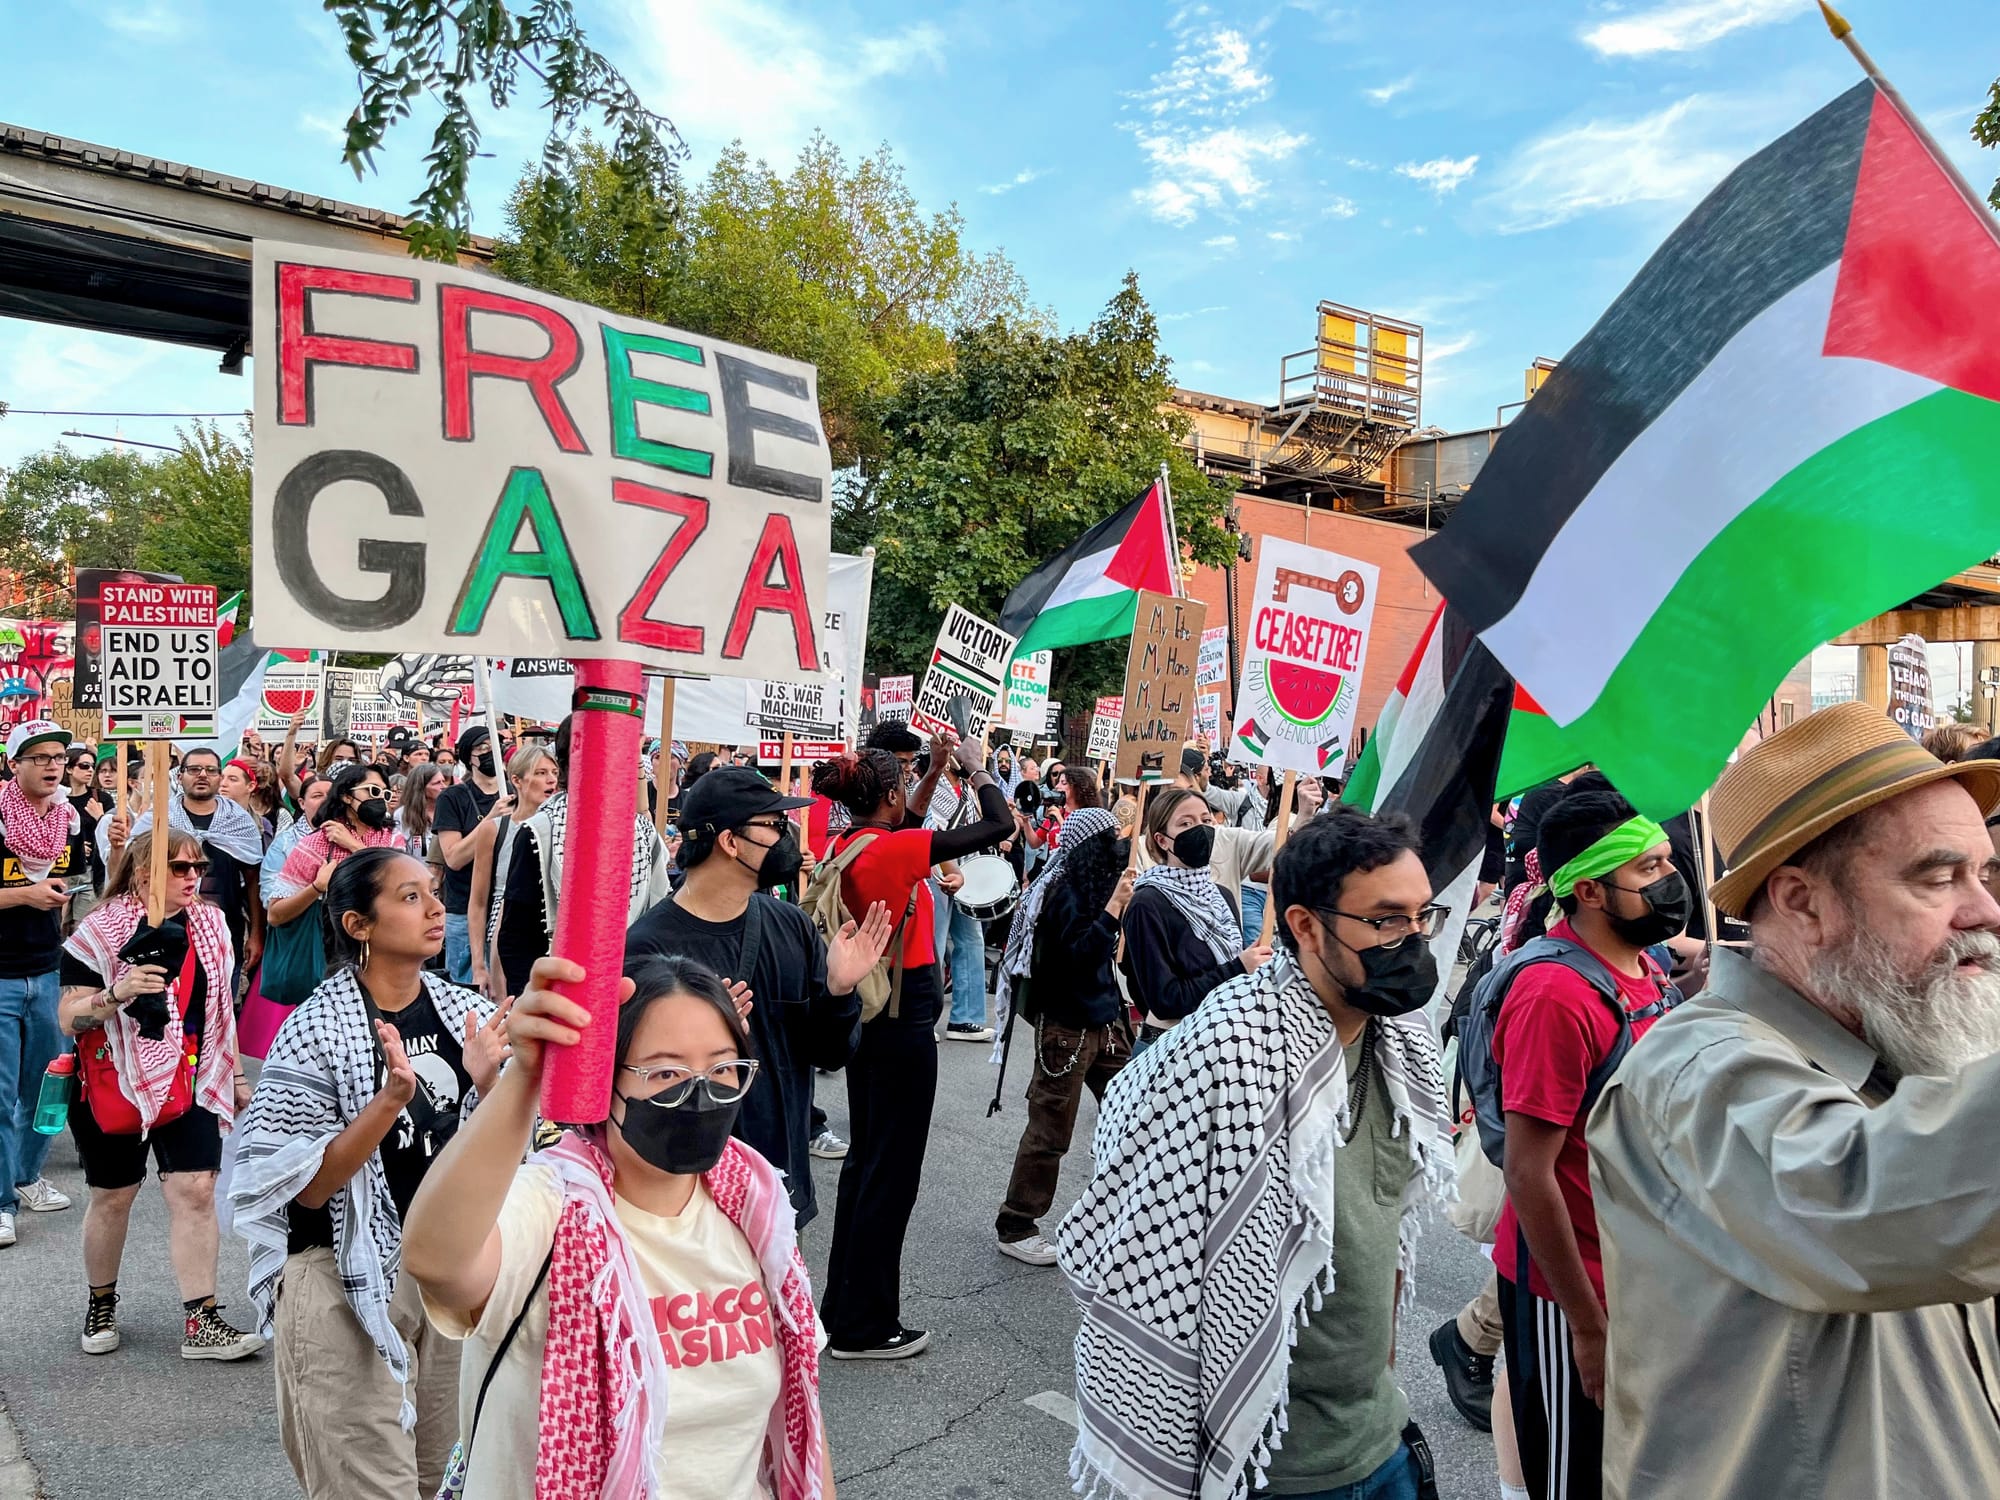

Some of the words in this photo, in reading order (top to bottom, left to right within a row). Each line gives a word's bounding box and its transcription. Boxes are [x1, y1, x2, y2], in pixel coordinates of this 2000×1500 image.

[274, 260, 822, 503] FREE
[272, 449, 821, 672] GAZA
[103, 587, 164, 603] STAND
[170, 589, 213, 604] WITH
[104, 605, 214, 623] PALESTINE!
[1148, 603, 1168, 644] My
[109, 633, 160, 653] END
[172, 633, 210, 653] U.S
[948, 610, 1012, 664] VICTORY
[1255, 606, 1363, 672] CEASEFIRE!
[109, 657, 161, 681] AID
[173, 658, 211, 681] TO
[516, 659, 575, 673] ANSWER
[960, 645, 970, 661] TO
[973, 652, 987, 669] THE
[1035, 653, 1046, 665] IS
[1141, 641, 1162, 680] My
[1012, 679, 1048, 695] EEDOM
[1248, 660, 1264, 691] END
[111, 685, 211, 707] ISRAEL!
[592, 694, 629, 706] PALESTINE
[765, 683, 789, 701] U.S.
[794, 687, 822, 706] WAR
[881, 688, 912, 705] CRIMES
[926, 669, 993, 717] PALESTINIAN
[1135, 680, 1152, 719] My
[761, 698, 823, 721] MACHINE!
[918, 690, 986, 738] RESISCE
[1255, 693, 1276, 724] THE
[1093, 727, 1110, 737] AID
[1095, 717, 1111, 727] END
[1276, 718, 1332, 744] GENOCIDE
[764, 745, 802, 757] FRO
[648, 1280, 770, 1334] ICAGO
[658, 1311, 773, 1369] ASIAN
